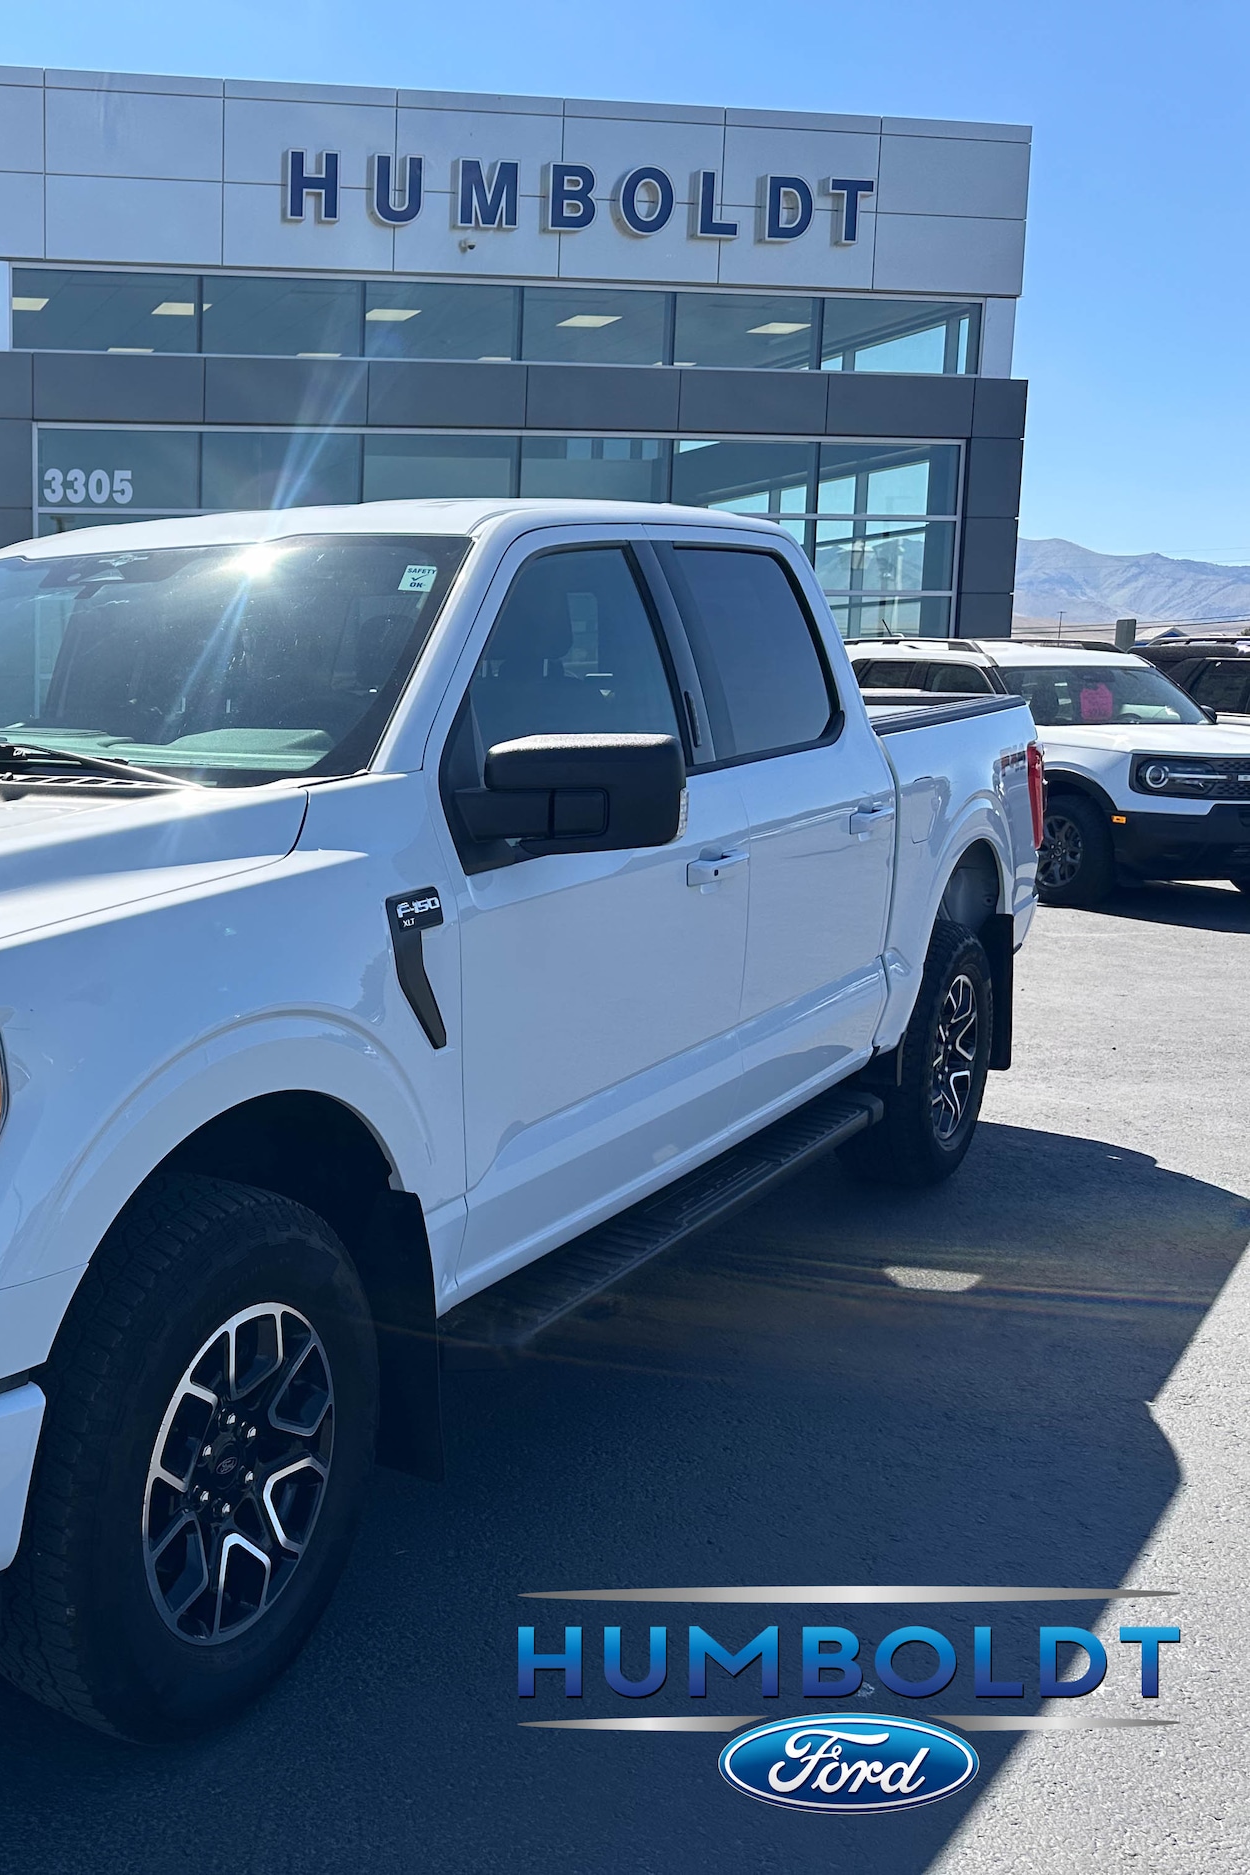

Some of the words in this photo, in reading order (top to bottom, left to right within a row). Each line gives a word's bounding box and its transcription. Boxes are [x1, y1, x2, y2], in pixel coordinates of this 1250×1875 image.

[282, 147, 875, 246] HUMBOLDT
[43, 468, 134, 505] 3305
[396, 896, 440, 919] F-150
[402, 918, 415, 928] XLT
